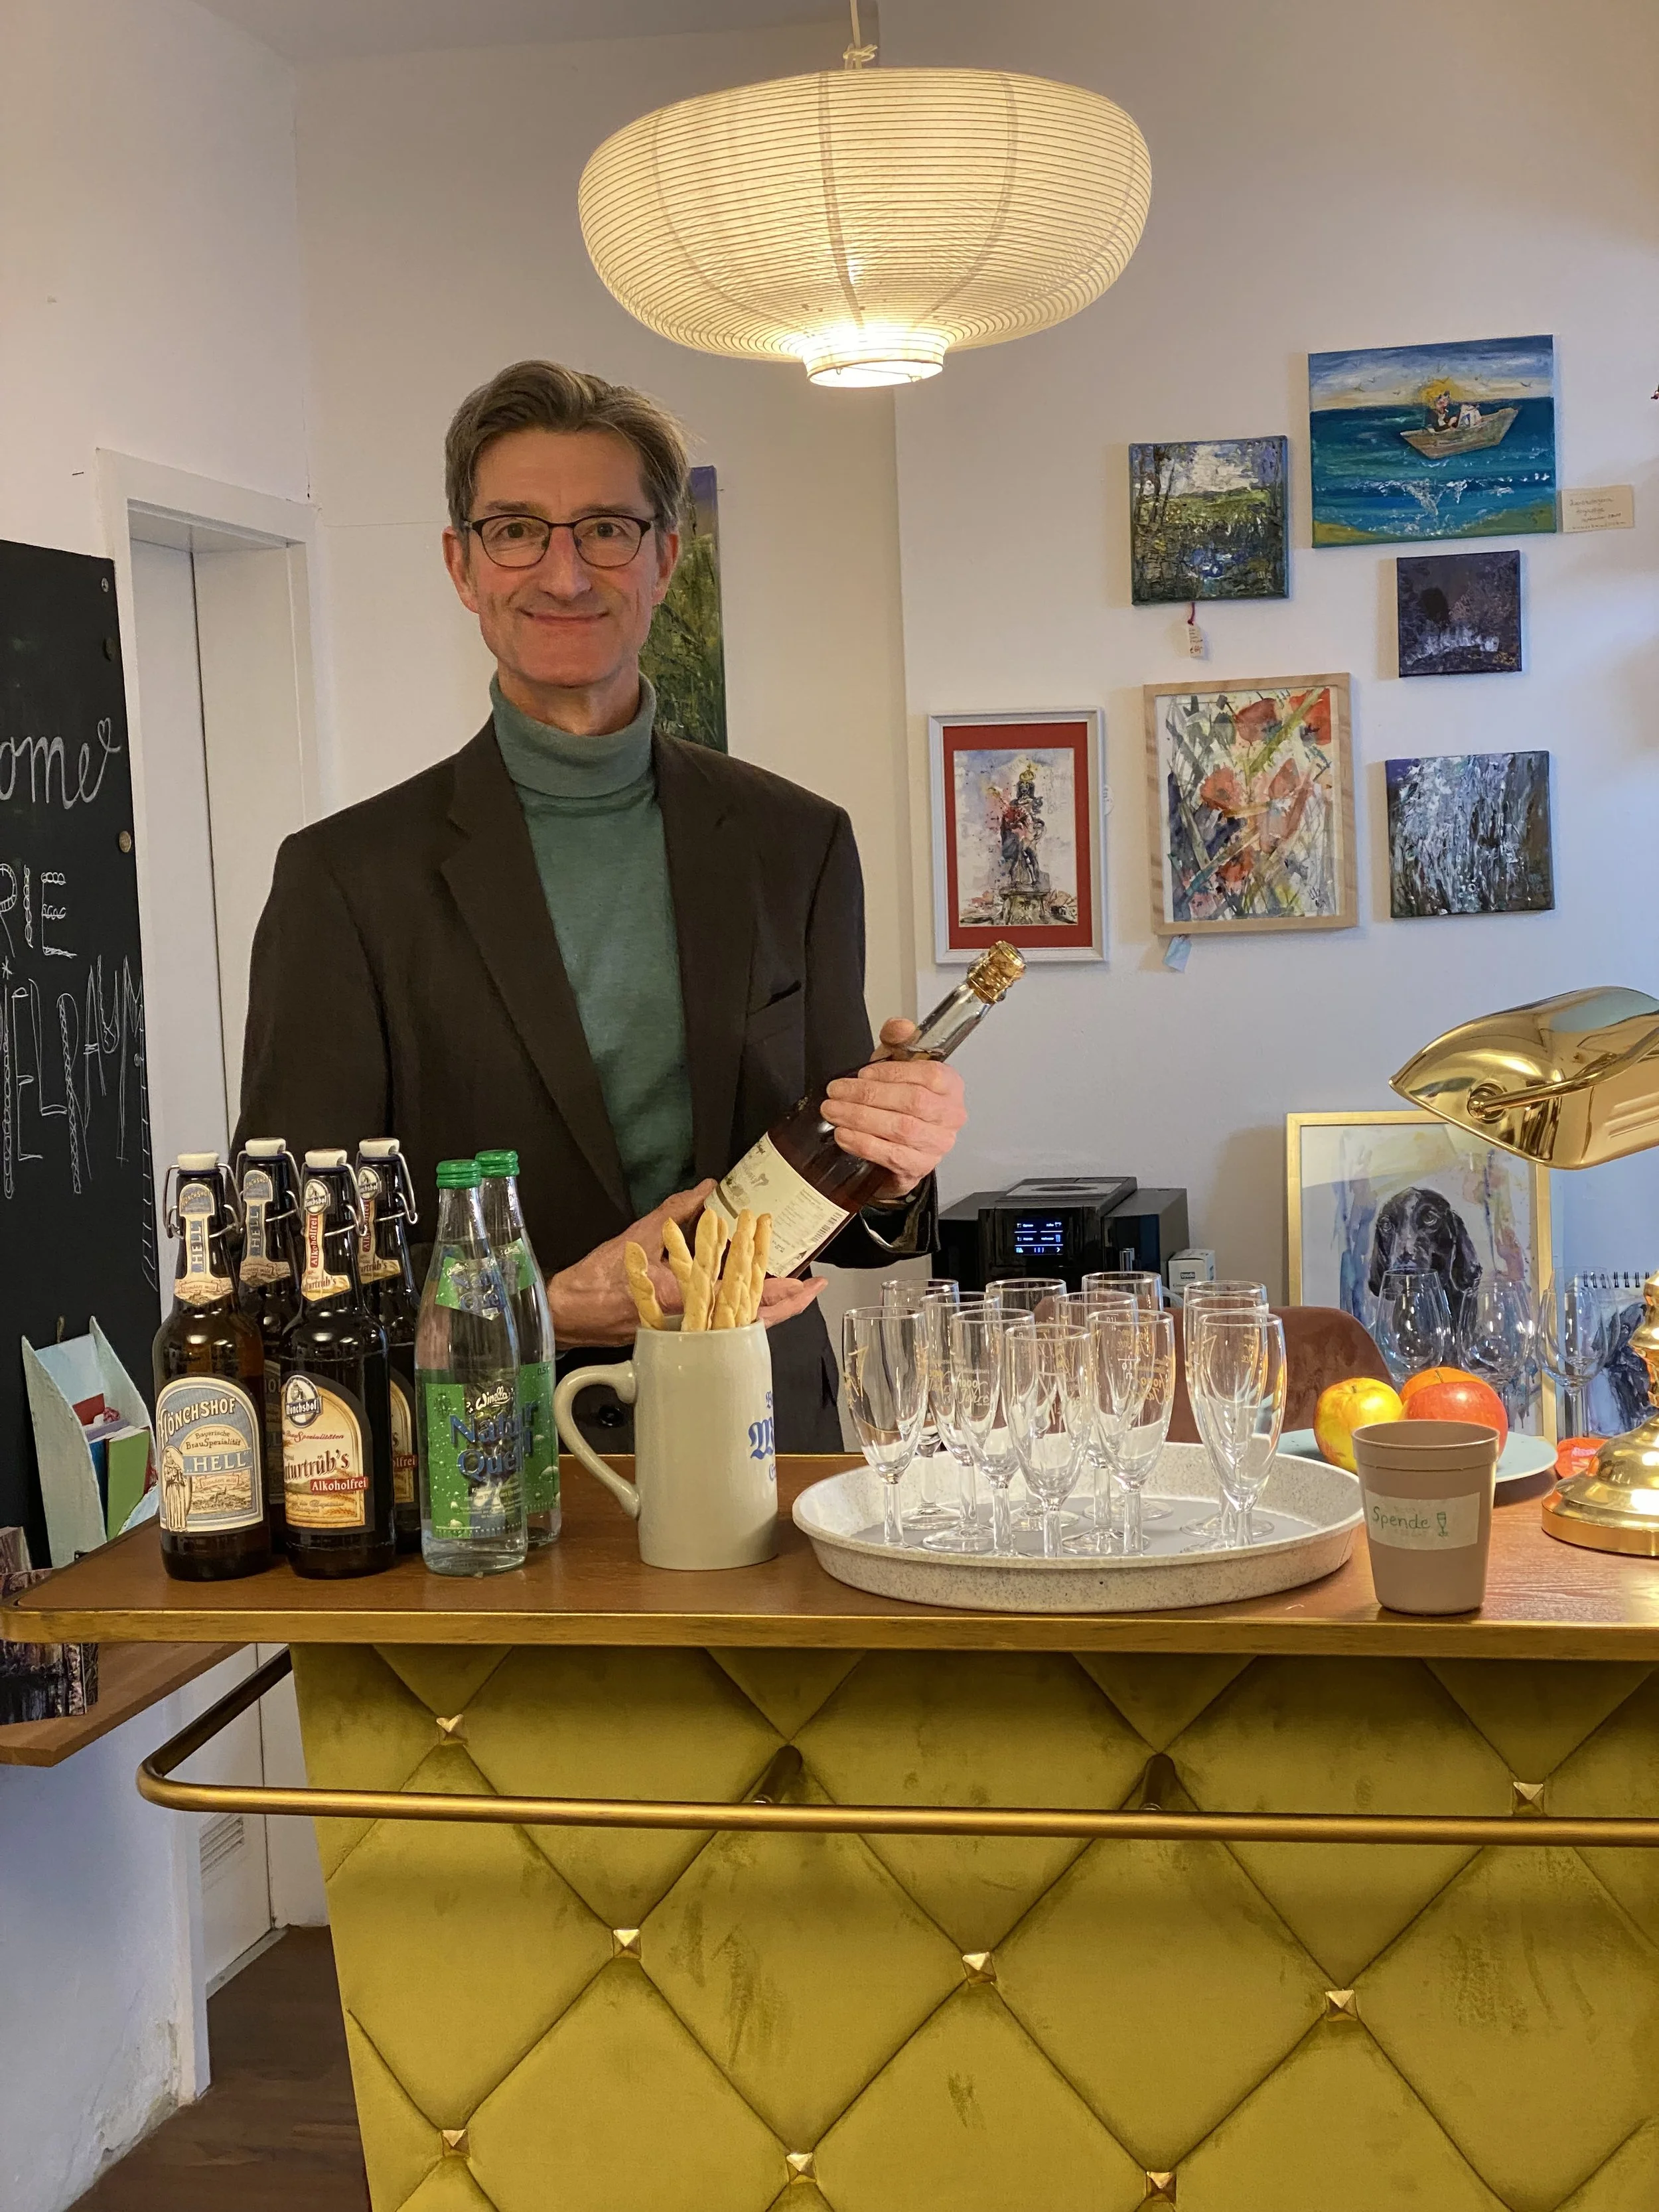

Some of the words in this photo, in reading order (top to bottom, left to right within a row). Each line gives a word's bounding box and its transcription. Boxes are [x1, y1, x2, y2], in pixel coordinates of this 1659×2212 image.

[195, 1430, 231, 1439] Bayerische
[311, 1477, 366, 1491] Alkoholfrei
[1372, 1505, 1431, 1529] Spende
